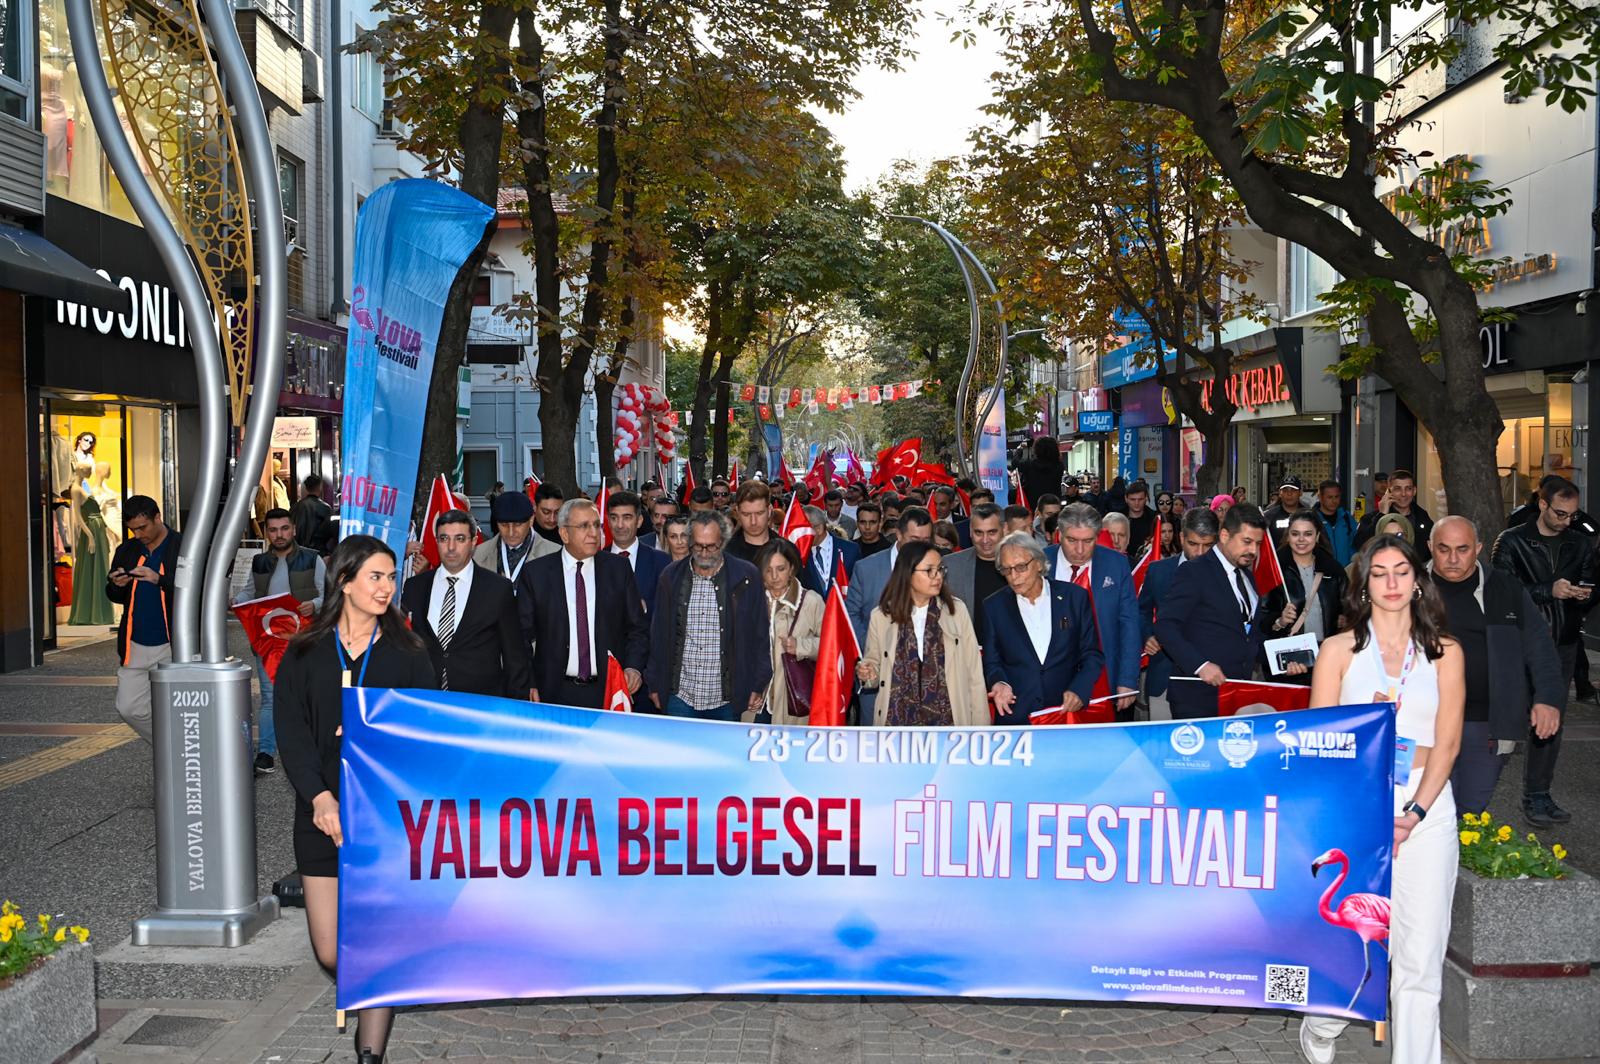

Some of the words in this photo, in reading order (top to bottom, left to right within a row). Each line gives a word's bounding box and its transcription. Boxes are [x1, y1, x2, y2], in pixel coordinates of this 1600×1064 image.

[1241, 364, 1283, 412] KEBAP
[1083, 413, 1111, 427] uğur
[1555, 429, 1586, 449] EKOL
[173, 691, 209, 707] 2020
[748, 727, 848, 763] 23-26
[948, 731, 1034, 767] 2024
[1298, 731, 1357, 749] YALOVA
[180, 711, 202, 816] BELEDİYESİ
[397, 797, 602, 880] YALOVA
[617, 795, 877, 878] BELGESEL
[893, 784, 1013, 878] FİLM
[1026, 790, 1279, 890] FESTİVALİ
[188, 821, 205, 892] YALOVA
[1091, 965, 1126, 976] Detaylı
[1129, 967, 1152, 977] Bilgi
[1168, 969, 1206, 979] Etkinlik
[1102, 982, 1246, 995] www.yalovafilmfestivali.com
